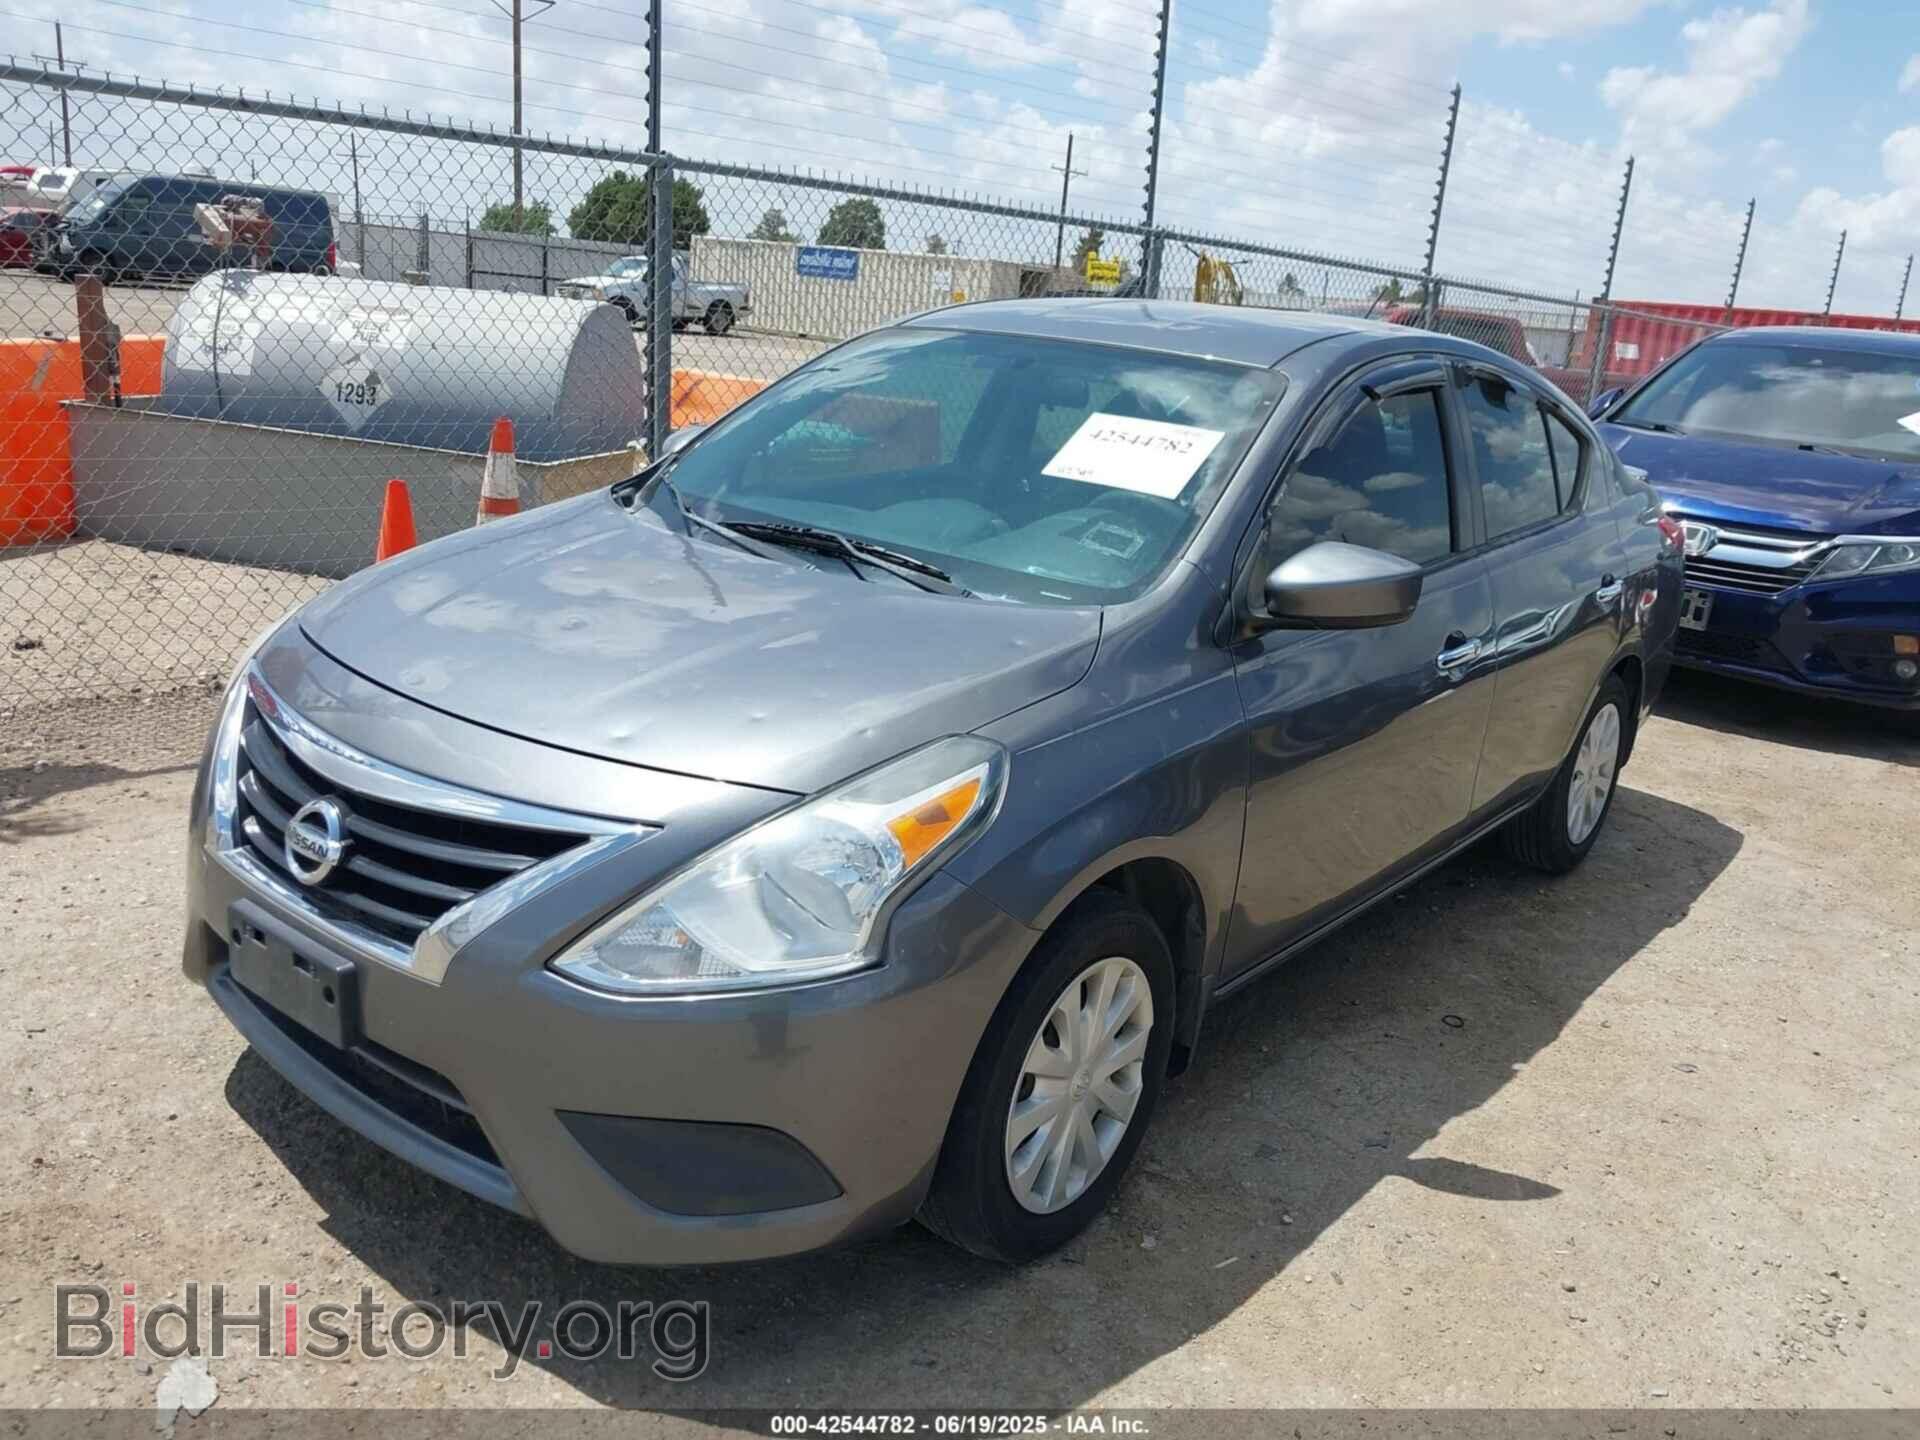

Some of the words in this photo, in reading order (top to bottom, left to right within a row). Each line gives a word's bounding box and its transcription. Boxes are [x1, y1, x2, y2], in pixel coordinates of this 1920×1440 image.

[336, 381, 377, 406] 1293
[1090, 428, 1194, 455] 42544782
[287, 824, 329, 859] SSAN
